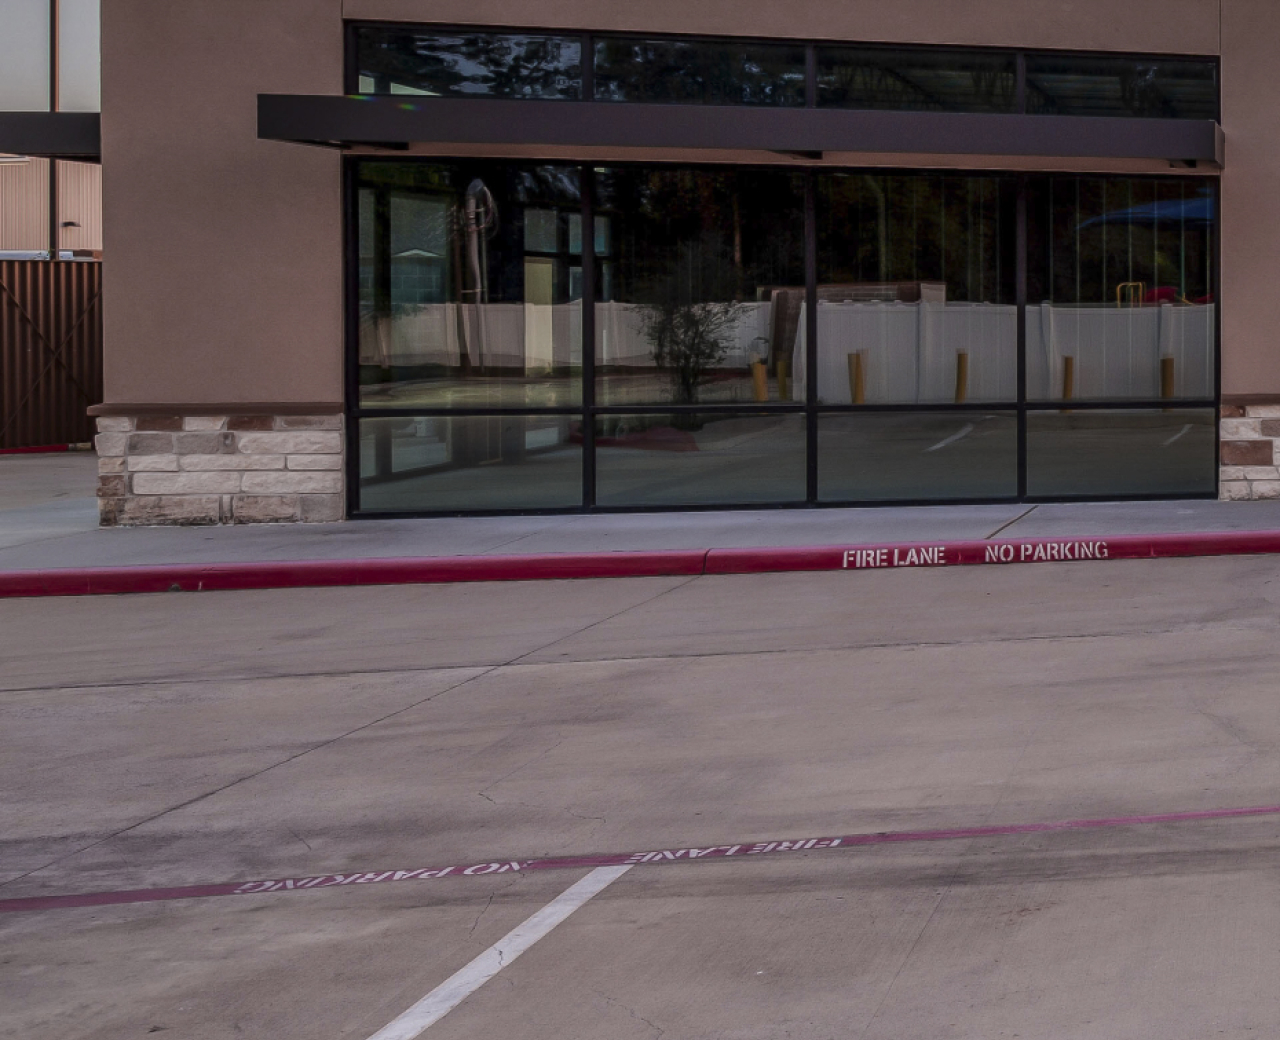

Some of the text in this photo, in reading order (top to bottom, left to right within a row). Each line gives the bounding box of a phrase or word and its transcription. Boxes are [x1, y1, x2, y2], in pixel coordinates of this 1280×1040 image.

[843, 541, 1109, 568] FIRE LANE NO PARKING
[624, 844, 742, 864] LANE
[747, 838, 842, 854] FIRE
[233, 865, 456, 893] PARKING
